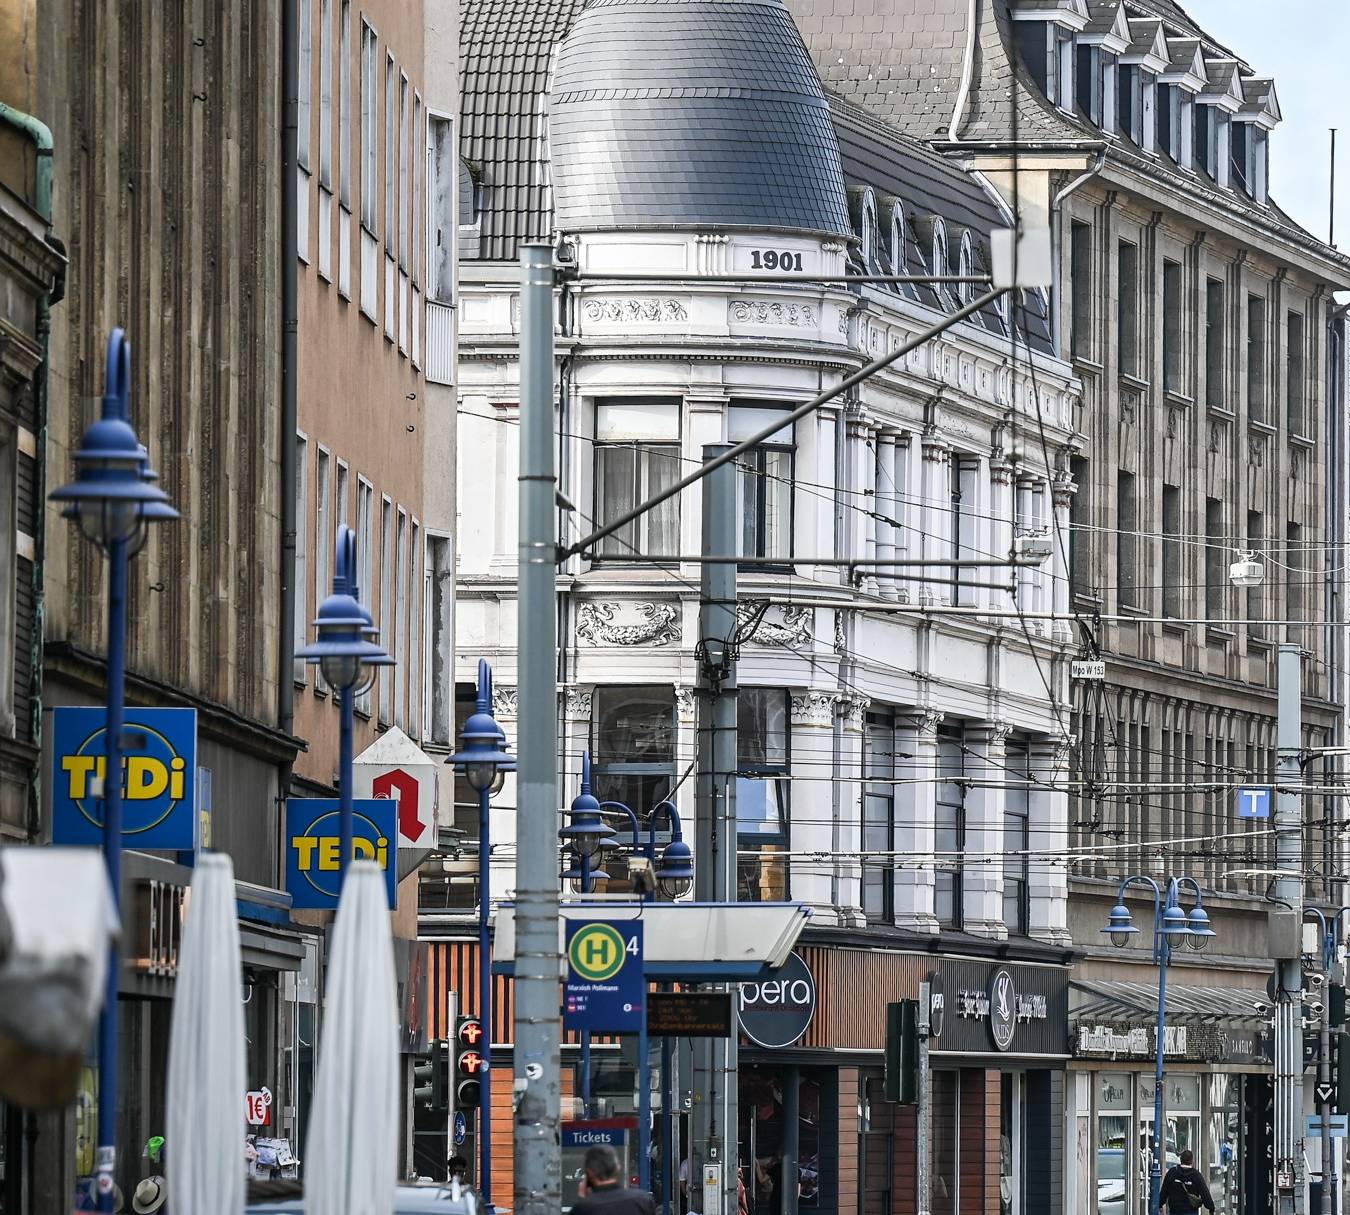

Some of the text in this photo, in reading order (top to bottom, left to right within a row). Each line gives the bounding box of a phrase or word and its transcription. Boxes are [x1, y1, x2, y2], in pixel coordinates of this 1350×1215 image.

[751, 250, 803, 272] 1901
[625, 936, 640, 956] 4
[247, 1095, 264, 1120] 1€
[573, 1131, 612, 1143] Tickets
